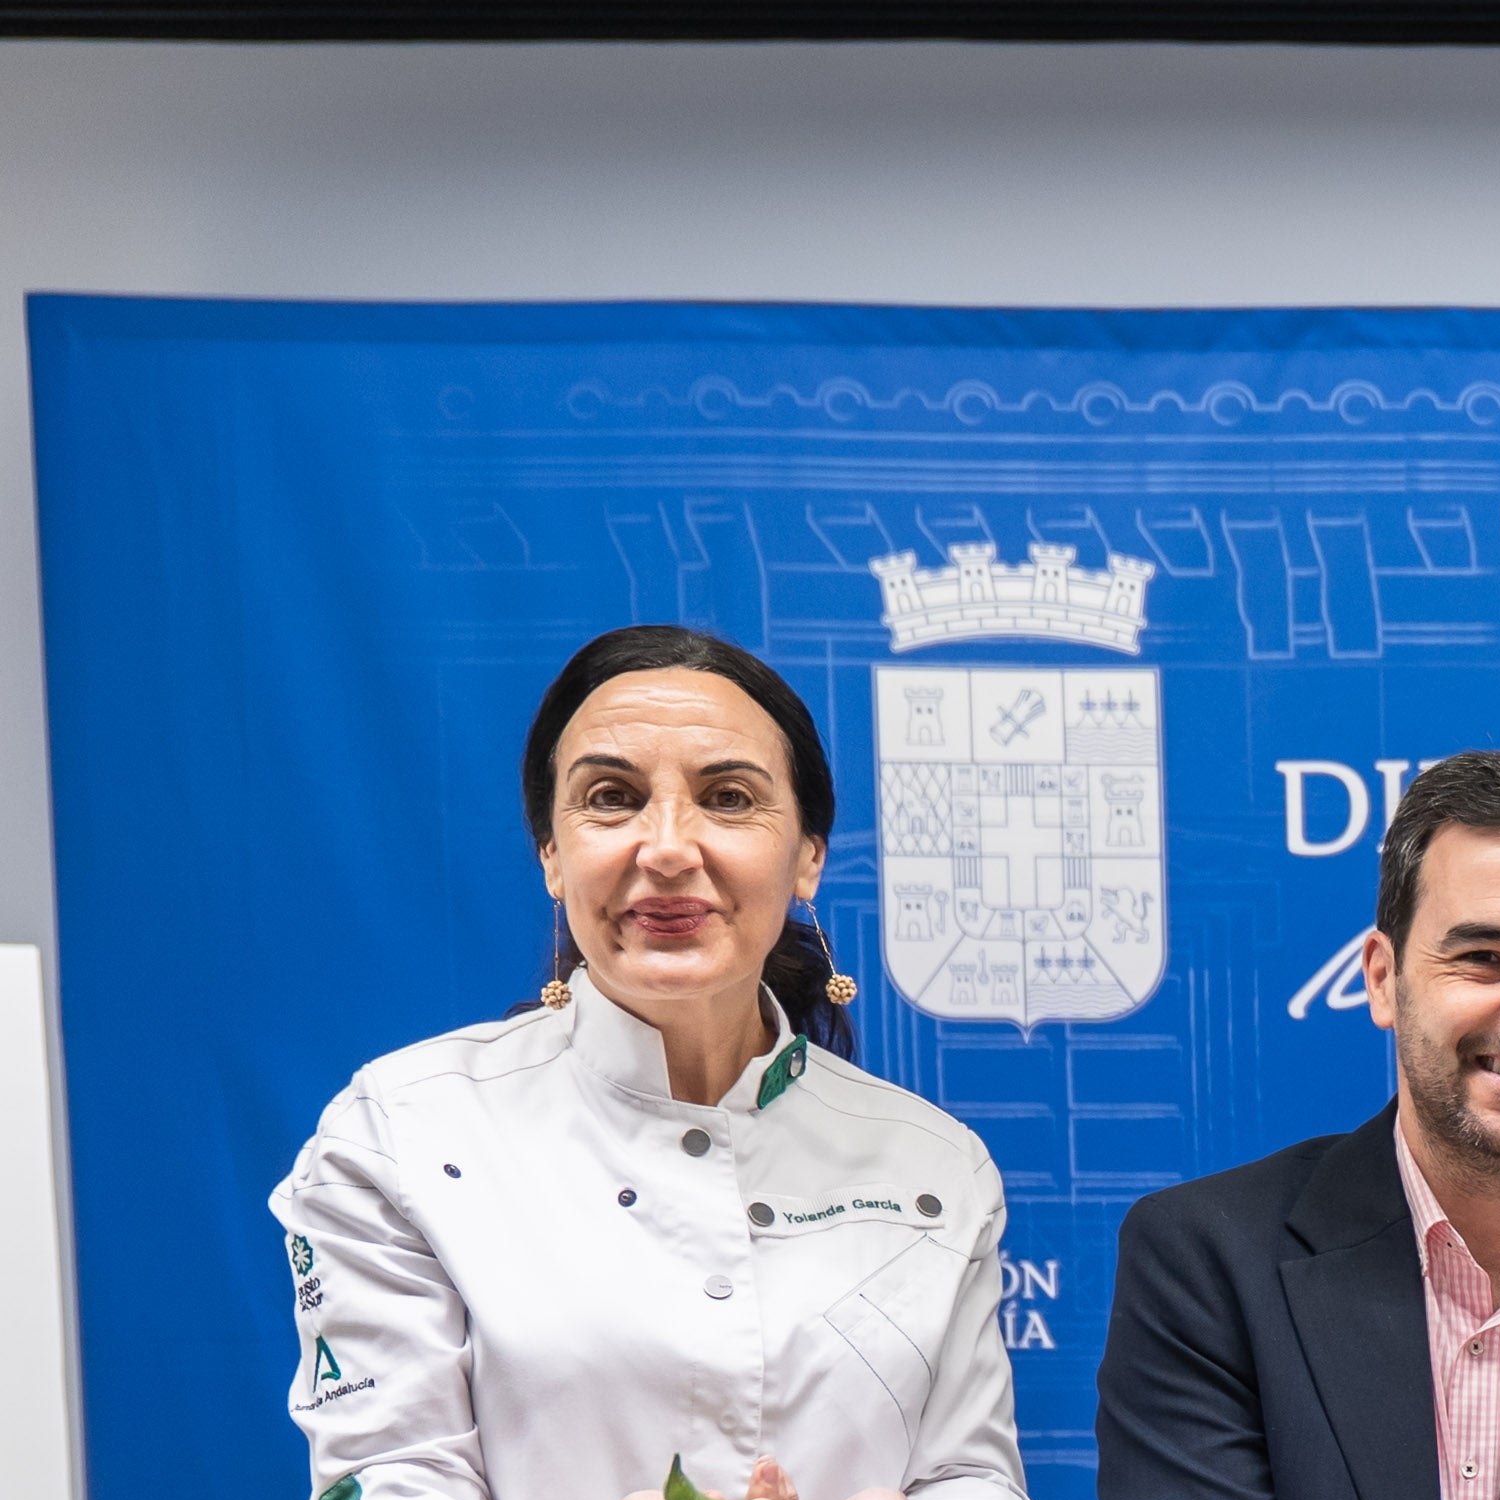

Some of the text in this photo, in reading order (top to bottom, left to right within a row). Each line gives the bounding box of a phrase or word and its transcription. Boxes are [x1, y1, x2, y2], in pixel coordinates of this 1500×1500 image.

[782, 1198, 903, 1224] Yolanda García
[324, 1377, 375, 1402] Andalucía
